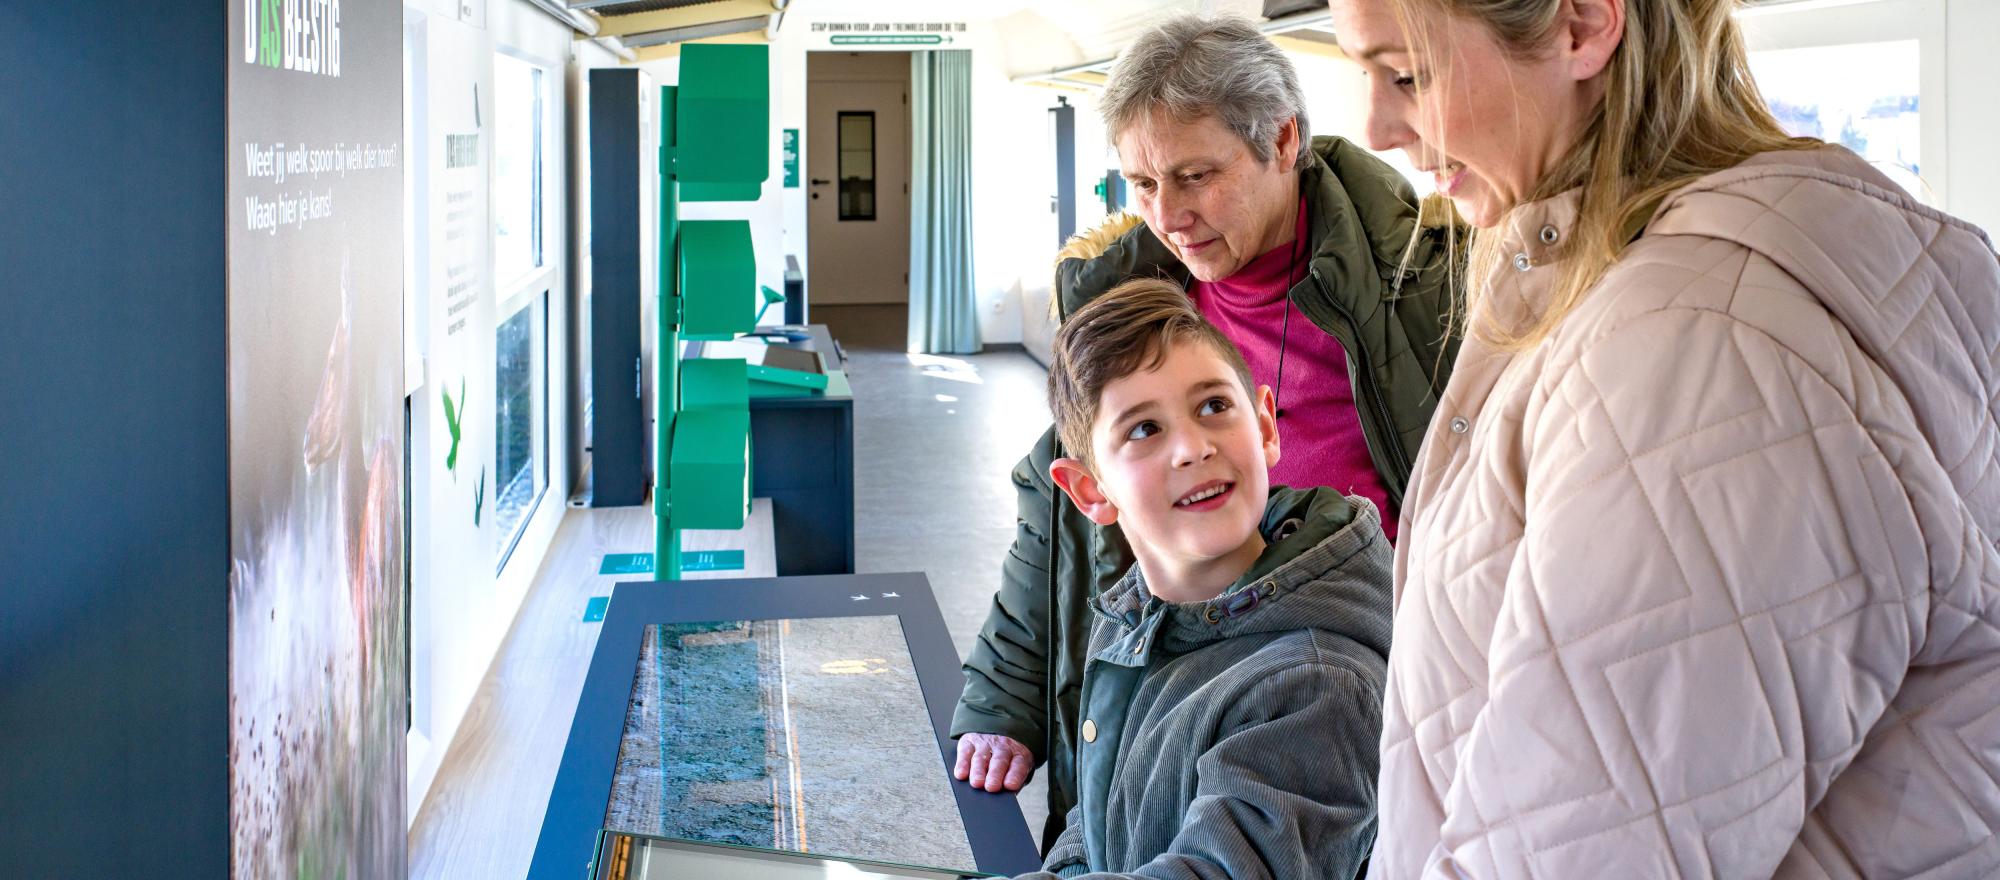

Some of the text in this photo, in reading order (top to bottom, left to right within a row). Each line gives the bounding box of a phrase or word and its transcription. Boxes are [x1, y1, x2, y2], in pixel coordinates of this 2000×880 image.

[259, 0, 281, 69] AS
[284, 0, 341, 78] BEESTIG
[854, 22, 870, 32] VOOR
[872, 22, 890, 32] JOUW
[926, 22, 943, 32] DOOR
[245, 142, 398, 184] Weet jij welk spoor bij welk dier hoort?
[245, 186, 332, 236] Waag hier je kans!
